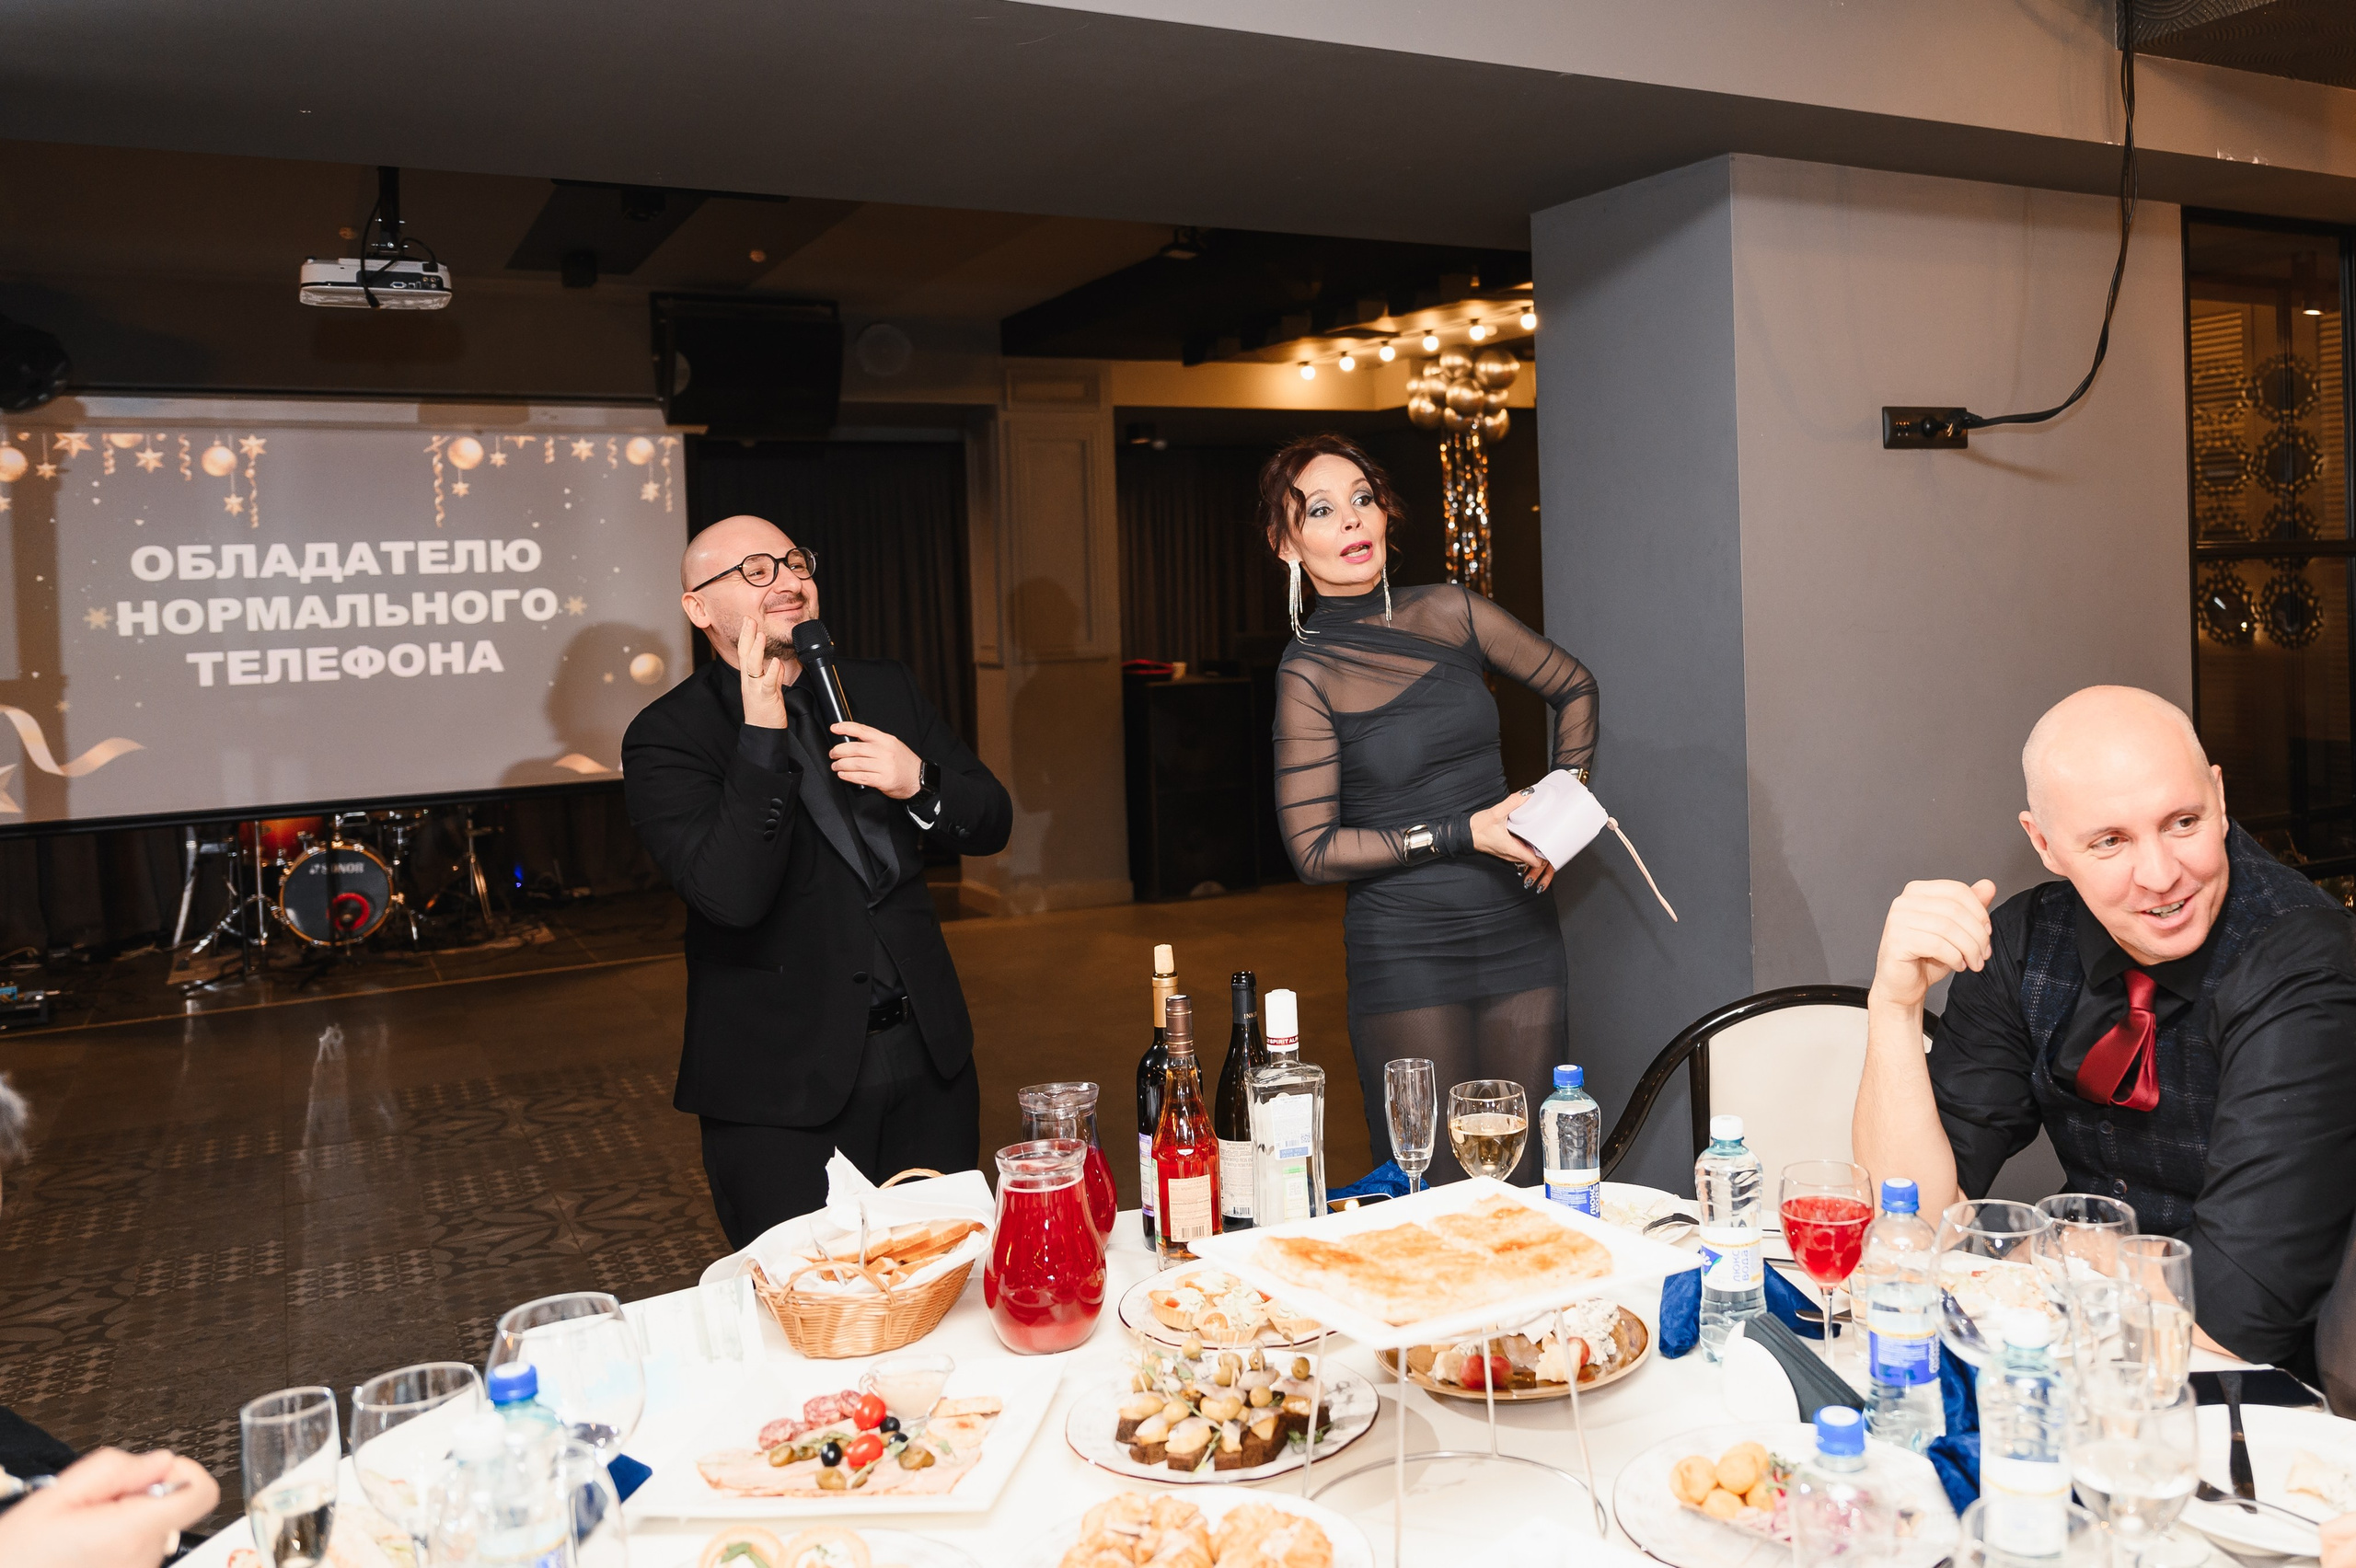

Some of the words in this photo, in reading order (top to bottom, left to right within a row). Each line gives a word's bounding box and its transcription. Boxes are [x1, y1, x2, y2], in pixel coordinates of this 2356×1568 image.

[131, 538, 541, 583] ОБЛАДАТЕЛЮ
[117, 588, 559, 636] НОРМАЛЬНОГО
[186, 640, 504, 686] ТЕЛЕФОНА
